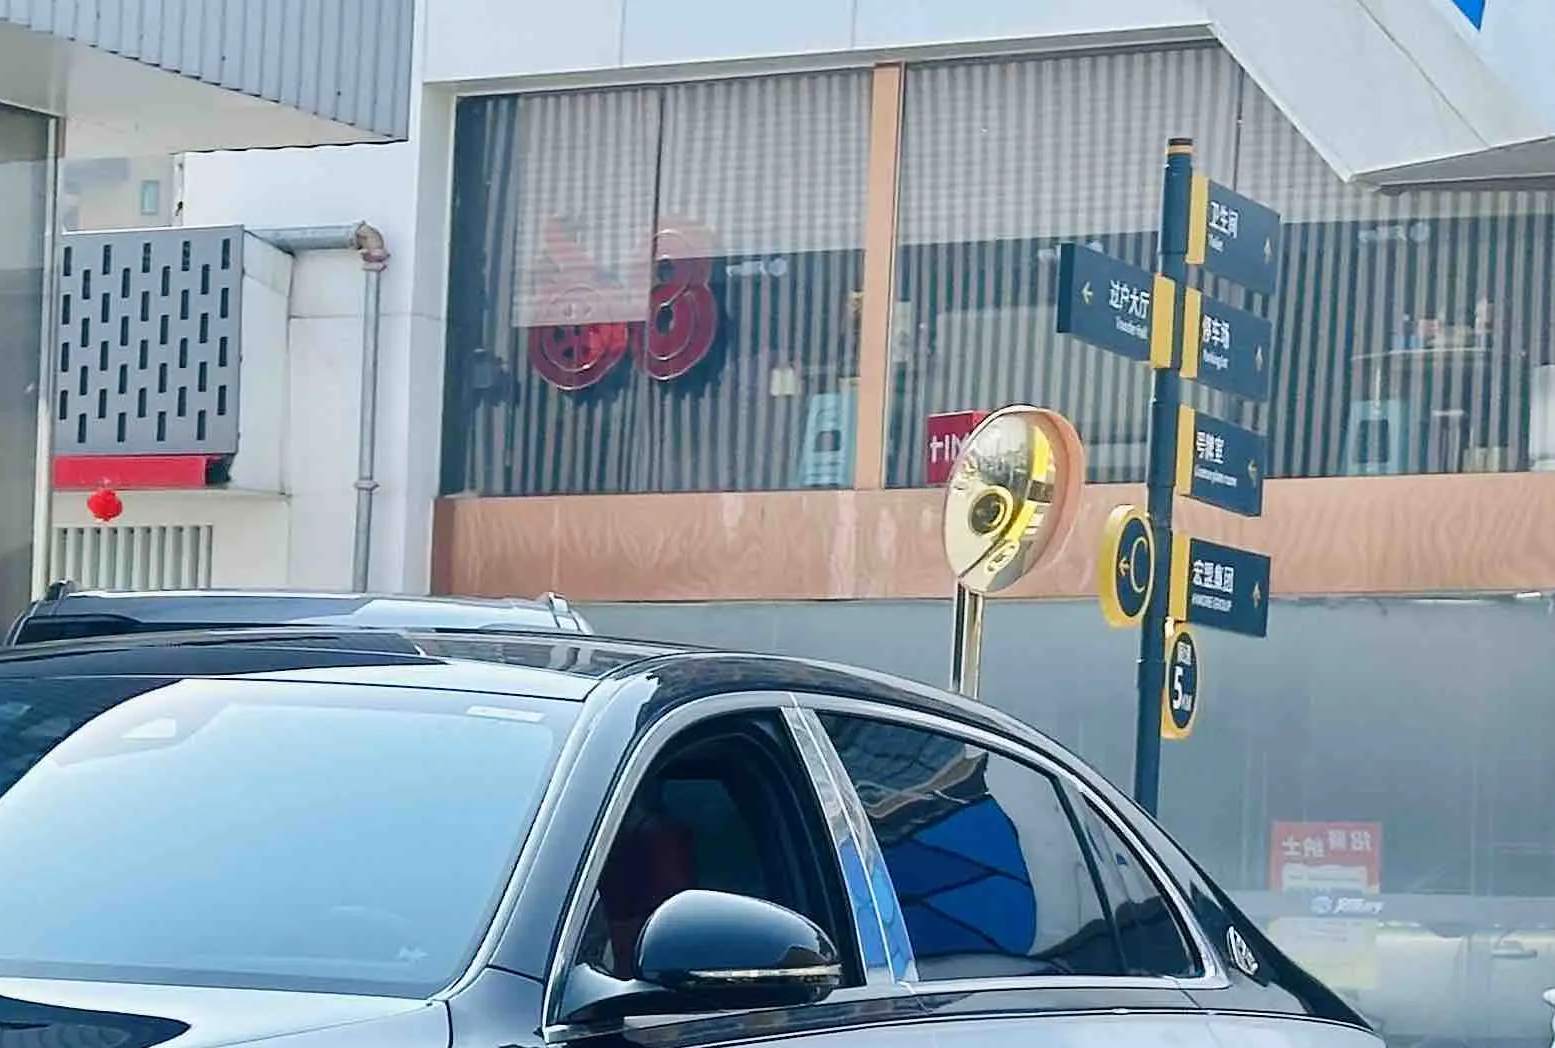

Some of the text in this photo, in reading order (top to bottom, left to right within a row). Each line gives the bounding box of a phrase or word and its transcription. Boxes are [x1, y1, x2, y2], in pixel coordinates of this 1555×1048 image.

[1109, 280, 1150, 319] 过户大厅
[1173, 665, 1184, 709] 5
